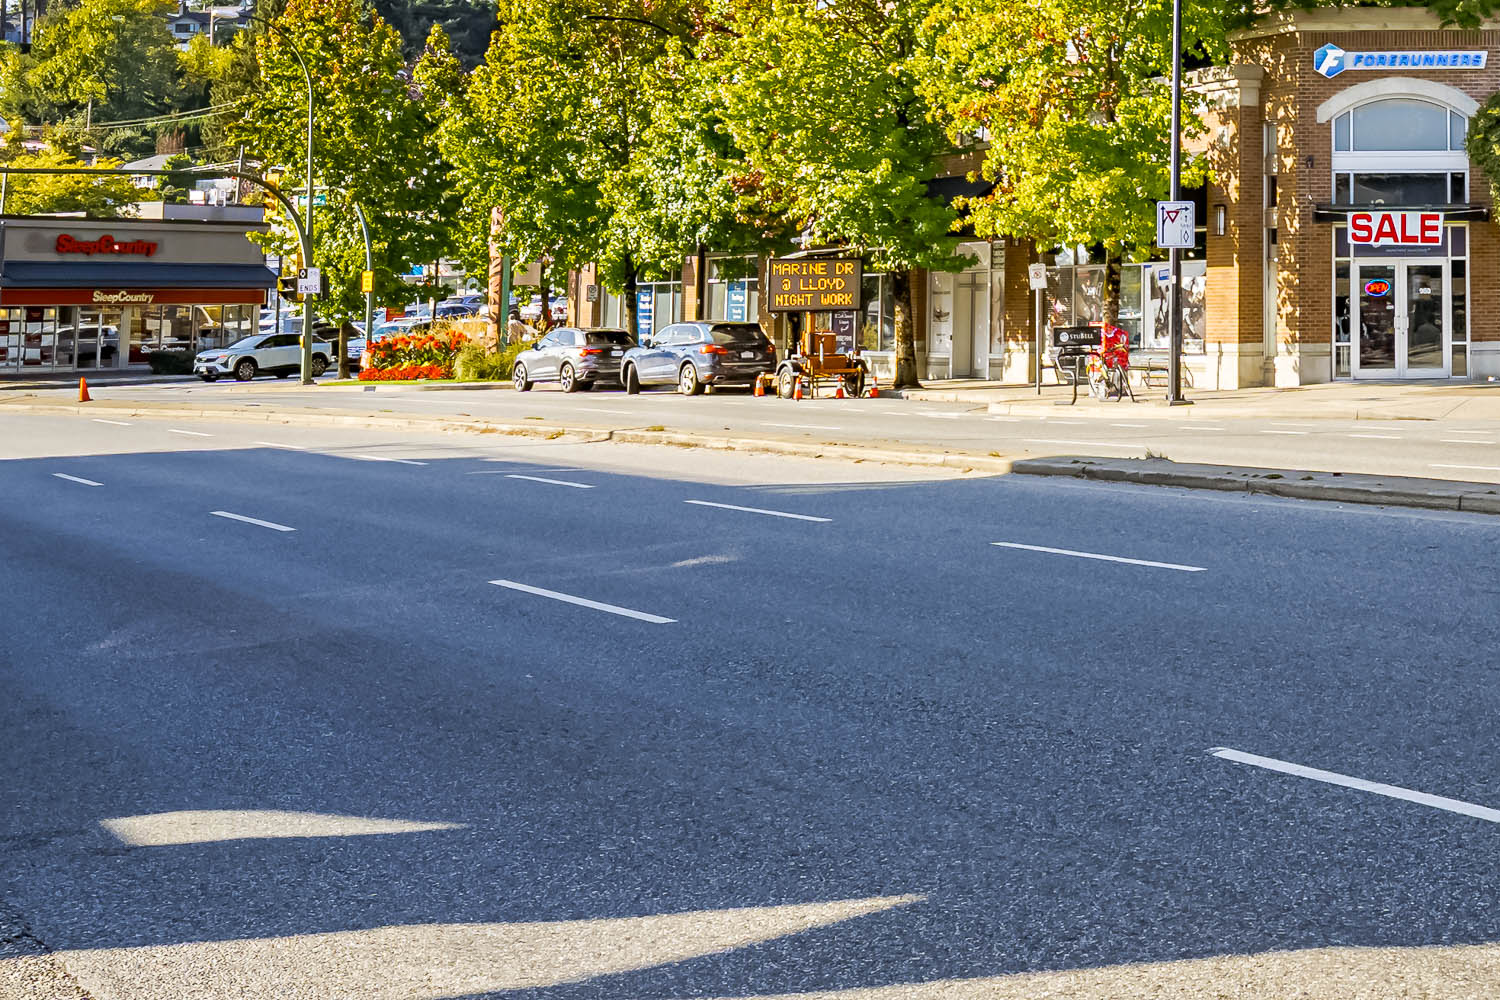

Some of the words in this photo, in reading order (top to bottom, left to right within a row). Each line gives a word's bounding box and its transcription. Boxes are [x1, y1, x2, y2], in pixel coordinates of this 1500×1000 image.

[1353, 54, 1482, 67] FORERUNNERS
[1351, 213, 1440, 243] SALE
[772, 263, 828, 275] MARINE
[835, 262, 854, 275] DR
[299, 284, 318, 292] ENDS
[782, 278, 791, 291] @
[799, 277, 846, 291] LLOYD
[775, 293, 814, 306] NIGHT
[820, 293, 853, 305] WORK
